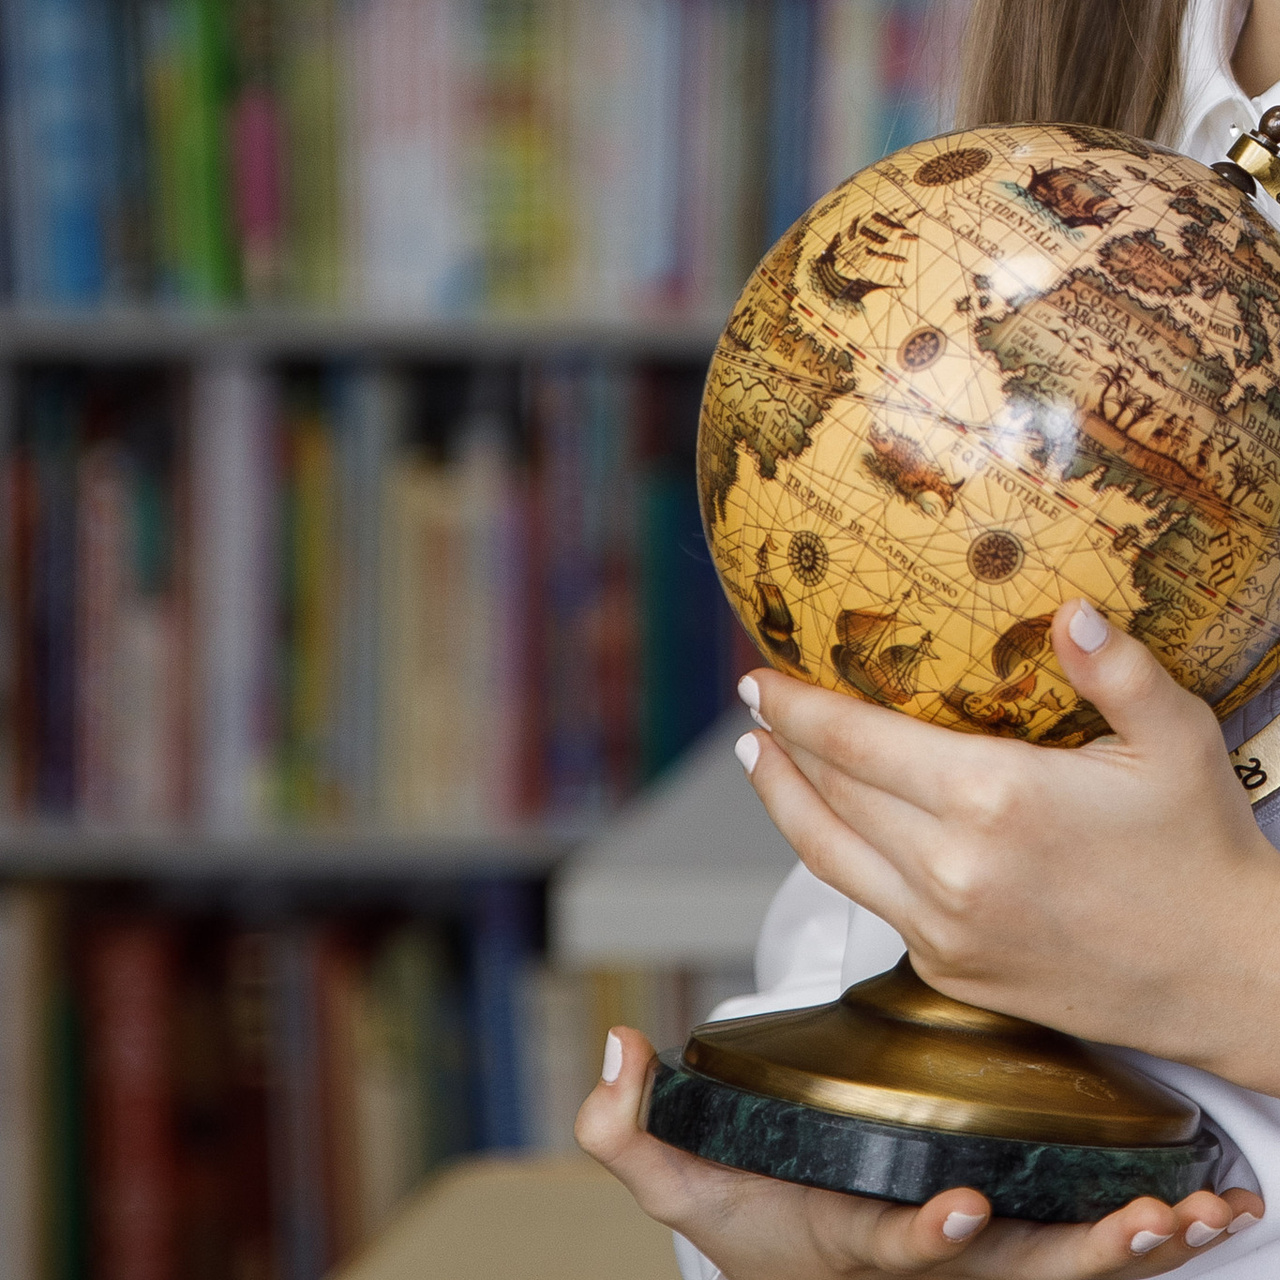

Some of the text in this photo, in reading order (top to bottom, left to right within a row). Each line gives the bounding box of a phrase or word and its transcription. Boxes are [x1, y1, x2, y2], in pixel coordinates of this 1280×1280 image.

[956, 223, 1005, 260] CANCRO
[965, 186, 1061, 255] OCCIDENTALE
[1052, 295, 1125, 344] MAROCHO
[1078, 287, 1131, 329] COSTA
[1135, 323, 1157, 346] DE
[1175, 298, 1205, 326] MARE
[950, 440, 1062, 521] EQUINOTIALE
[786, 473, 960, 599] TROPICHO DE CAPRICORNO
[1233, 757, 1267, 790] 20
